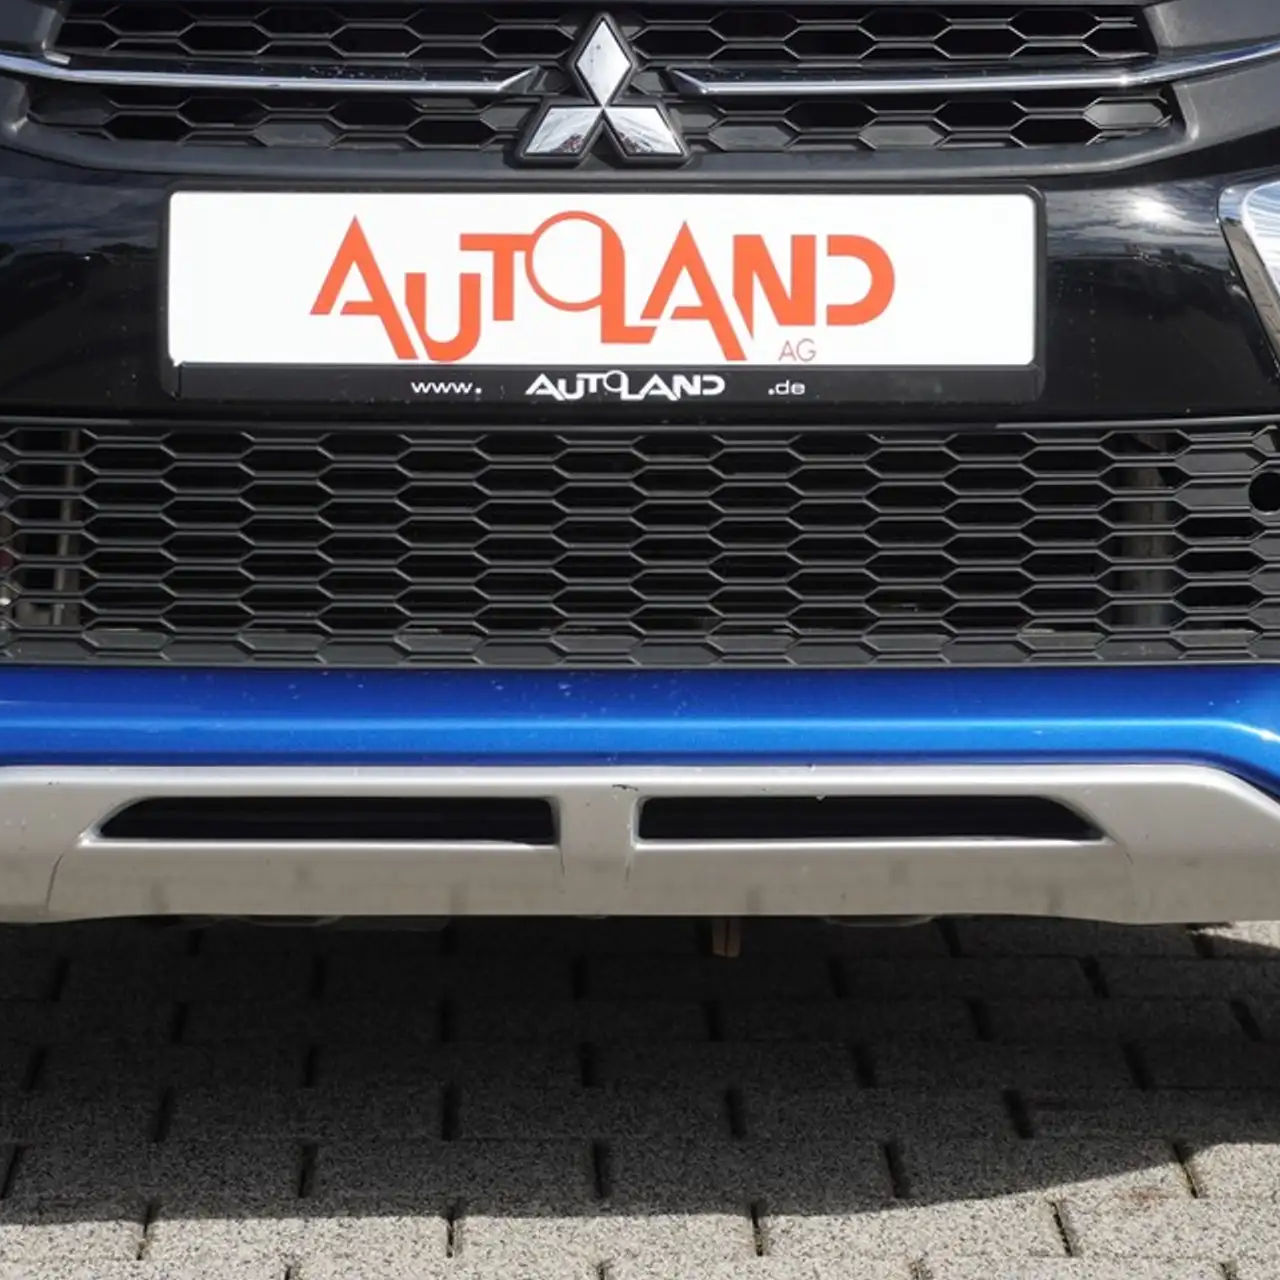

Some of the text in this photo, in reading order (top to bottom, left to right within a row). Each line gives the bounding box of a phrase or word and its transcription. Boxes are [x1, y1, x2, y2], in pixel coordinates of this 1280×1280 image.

[778, 338, 817, 362] AG
[410, 382, 483, 395] www.
[767, 379, 806, 396] .de
